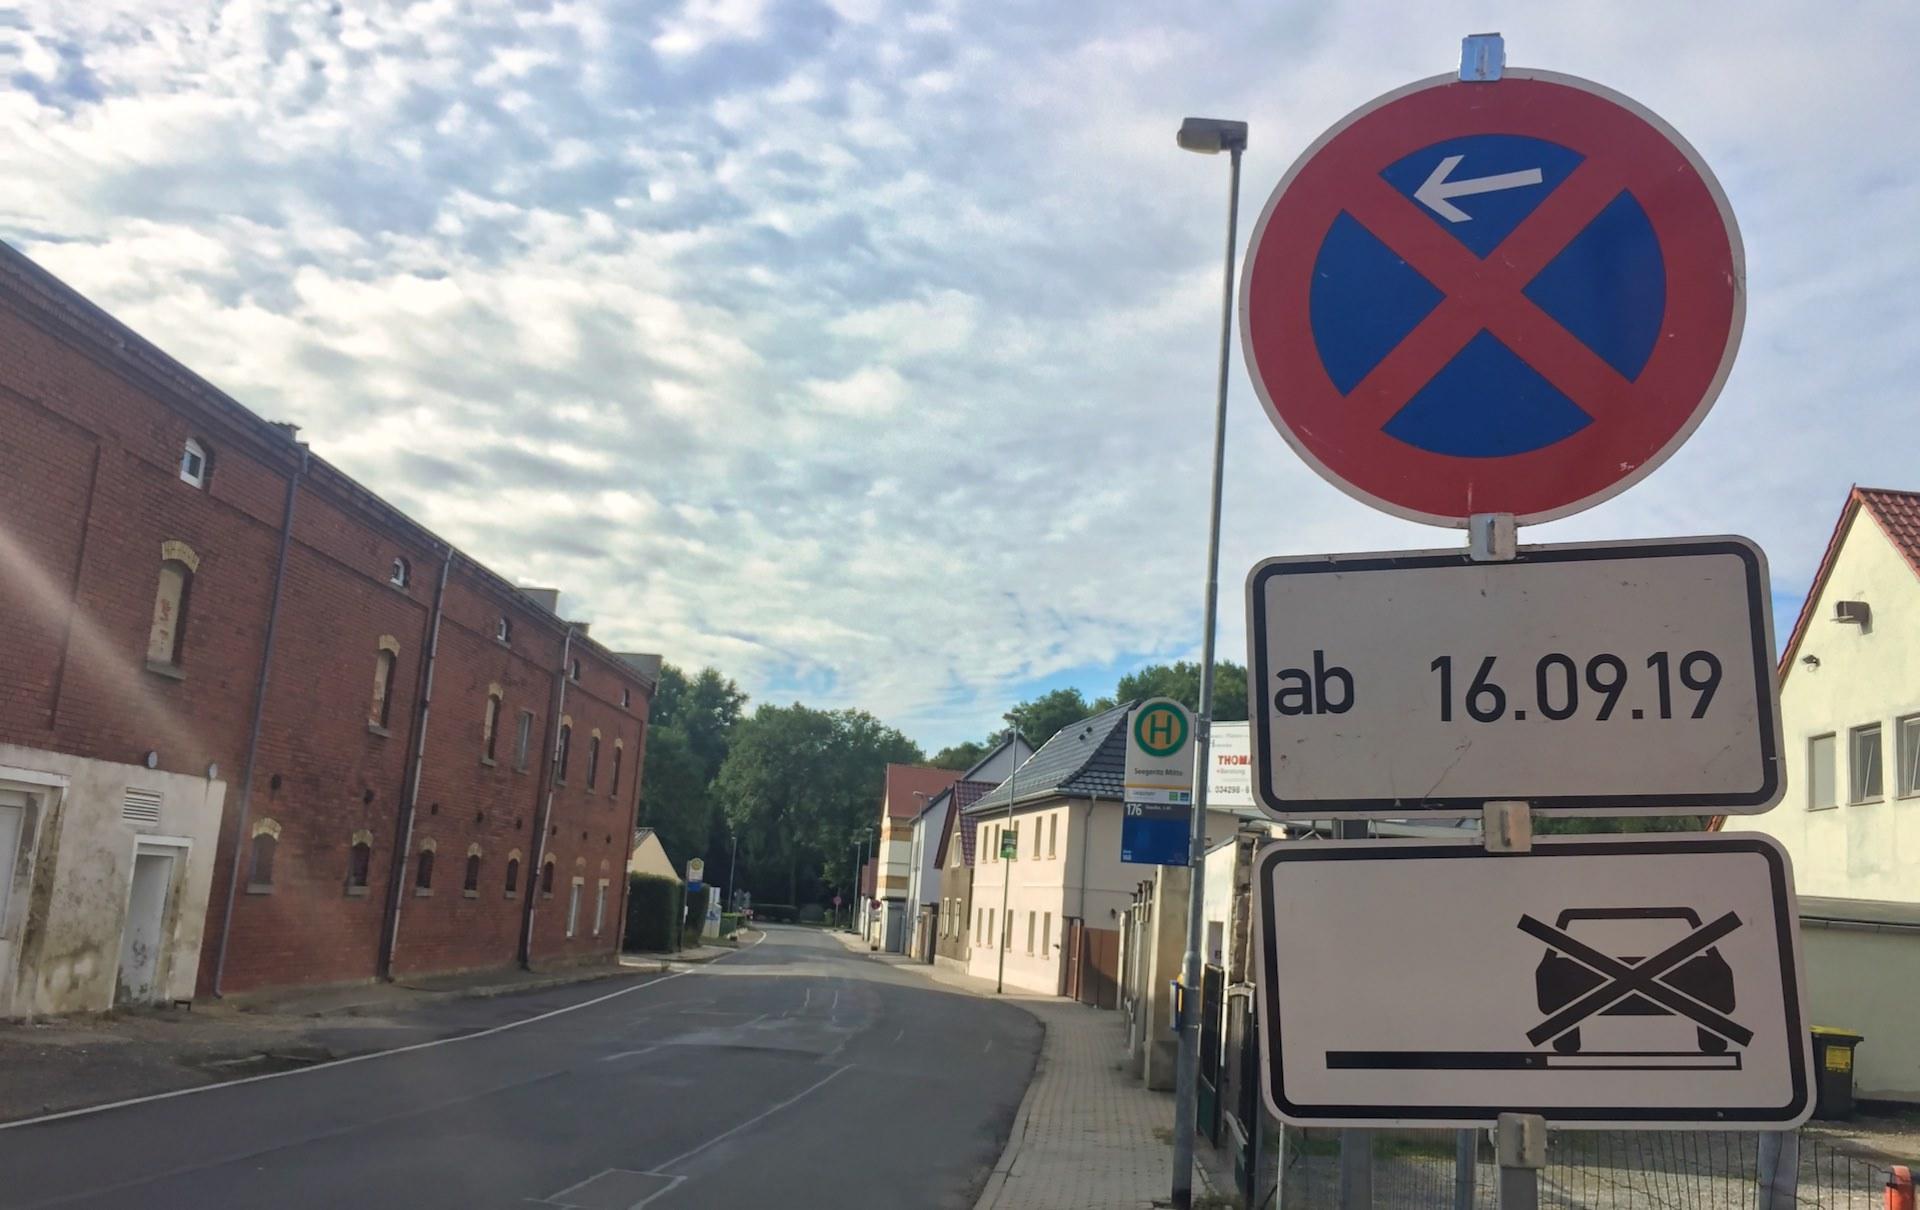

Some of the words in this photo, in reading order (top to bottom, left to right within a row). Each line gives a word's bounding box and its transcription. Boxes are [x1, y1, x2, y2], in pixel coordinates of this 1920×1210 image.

[1274, 649, 1355, 715] ab
[1430, 649, 1723, 723] 16.09.19
[1150, 713, 1173, 745] H
[1127, 803, 1143, 816] 176
